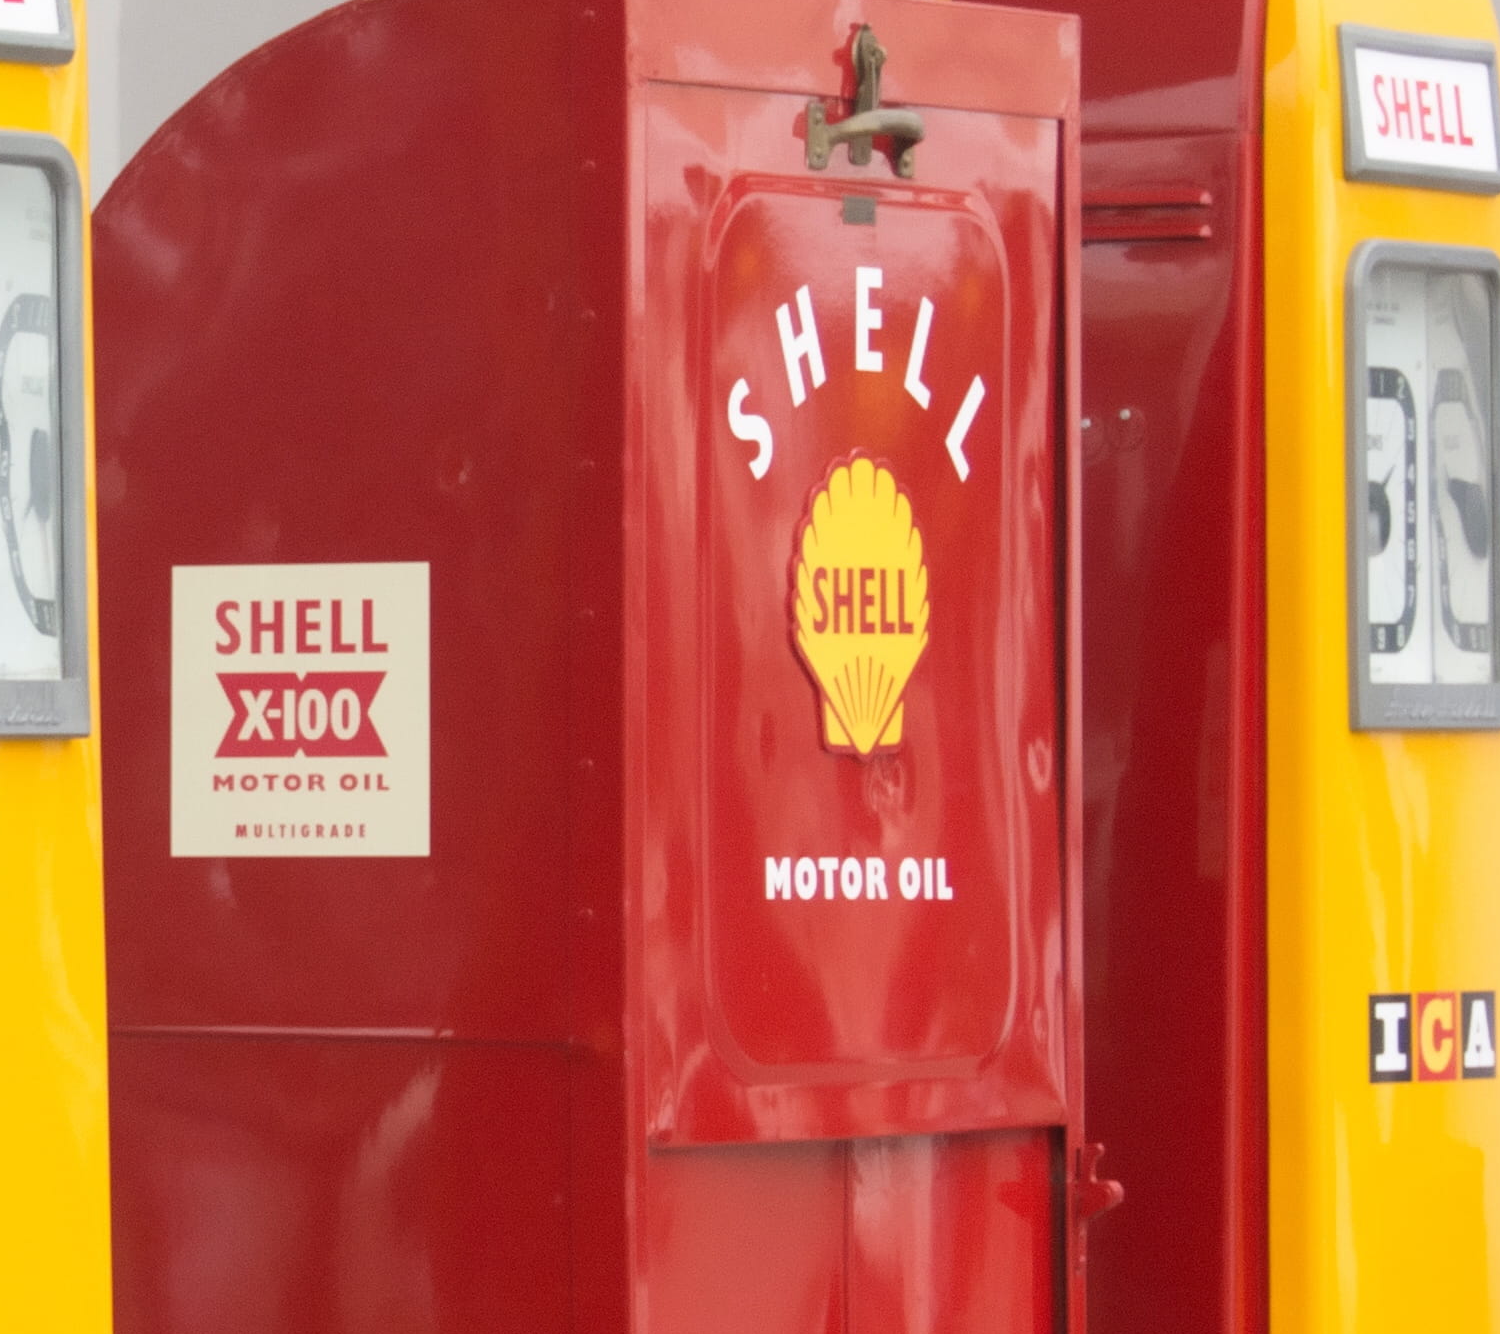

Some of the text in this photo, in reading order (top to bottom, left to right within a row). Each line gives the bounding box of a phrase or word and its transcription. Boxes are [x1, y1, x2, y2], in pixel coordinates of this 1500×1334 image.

[1373, 74, 1474, 147] SHELL
[727, 267, 985, 481] SHELL
[215, 598, 389, 655] SHELL
[812, 566, 914, 635] SHELL
[236, 687, 362, 742] X-100
[212, 773, 390, 792] MOTOR OIL
[235, 824, 367, 839] MULTIGRADE
[765, 856, 953, 900] MOTOR OIL
[1374, 998, 1496, 1073] ICA
